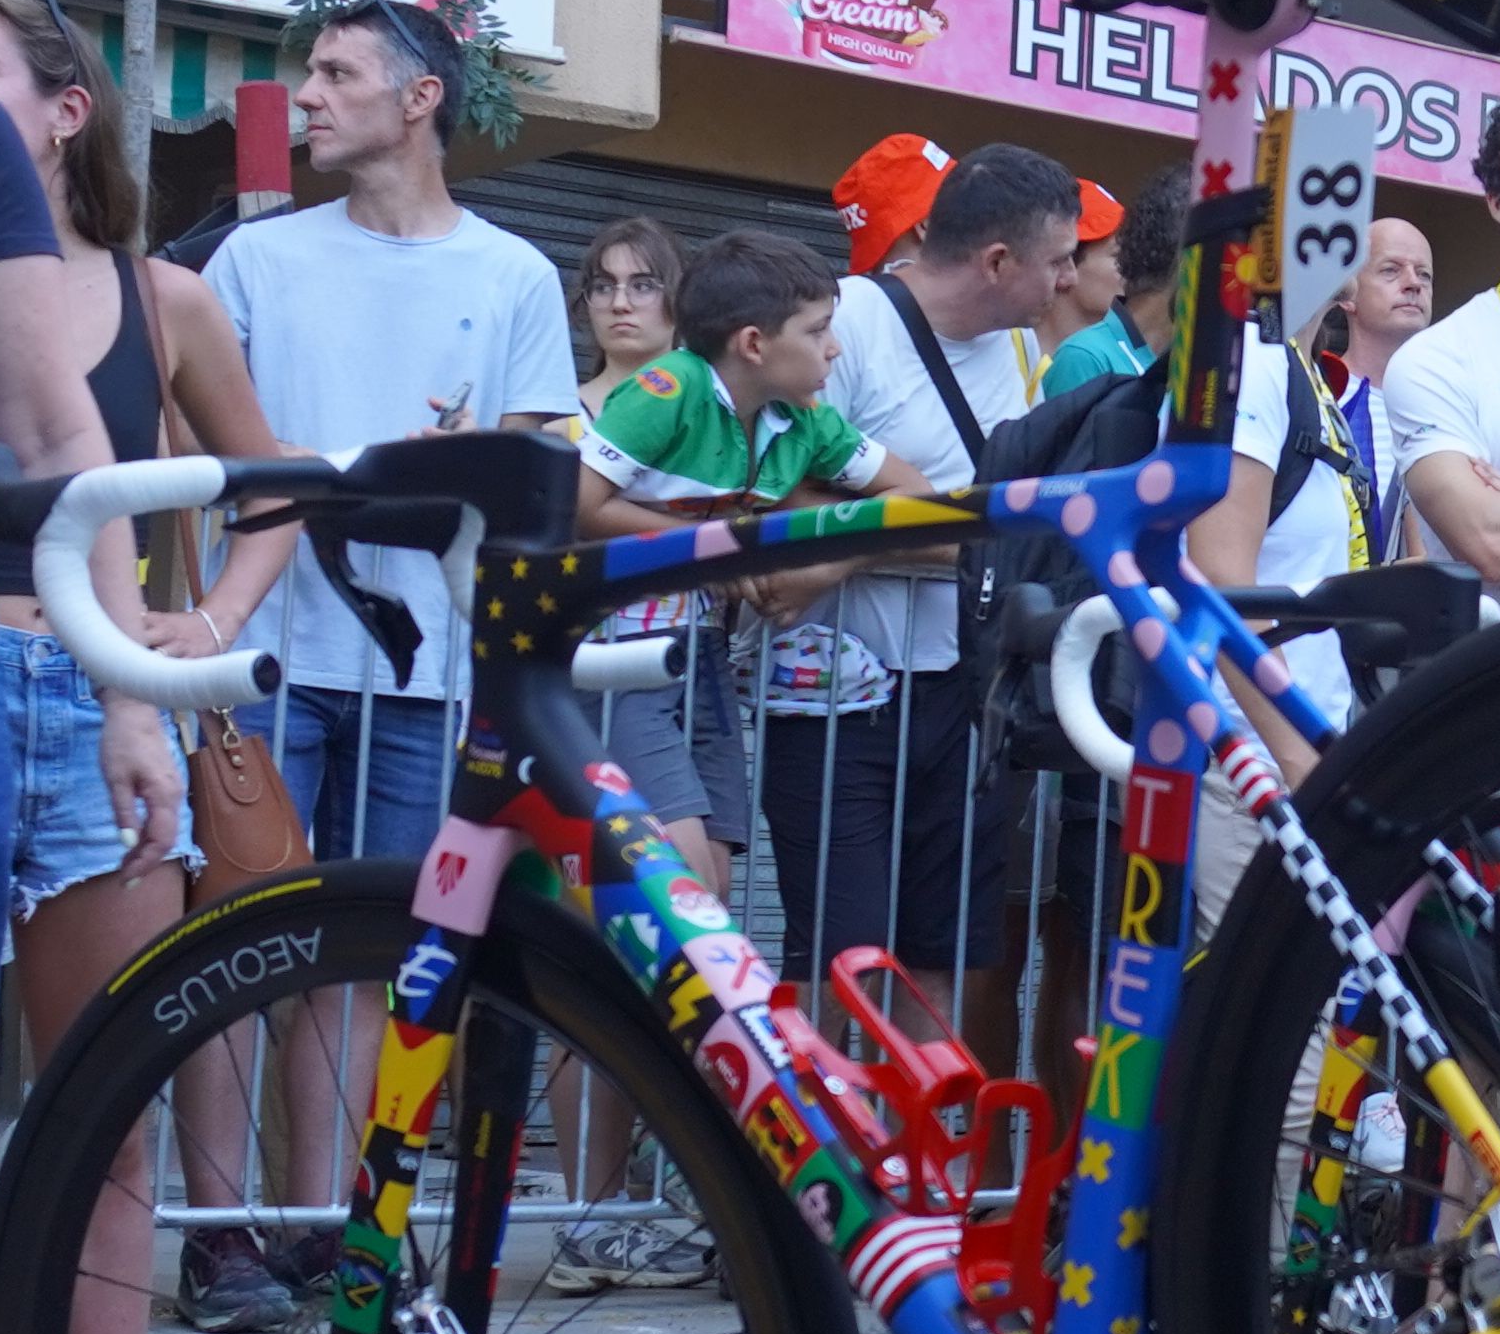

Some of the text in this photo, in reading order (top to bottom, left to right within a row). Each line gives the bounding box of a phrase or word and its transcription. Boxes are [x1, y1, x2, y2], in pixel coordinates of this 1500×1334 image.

[827, 31, 914, 65] HIGH QUALITY
[1298, 161, 1363, 268] 38
[154, 925, 324, 1036] AEOLUS
[1086, 774, 1177, 1119] TREK
